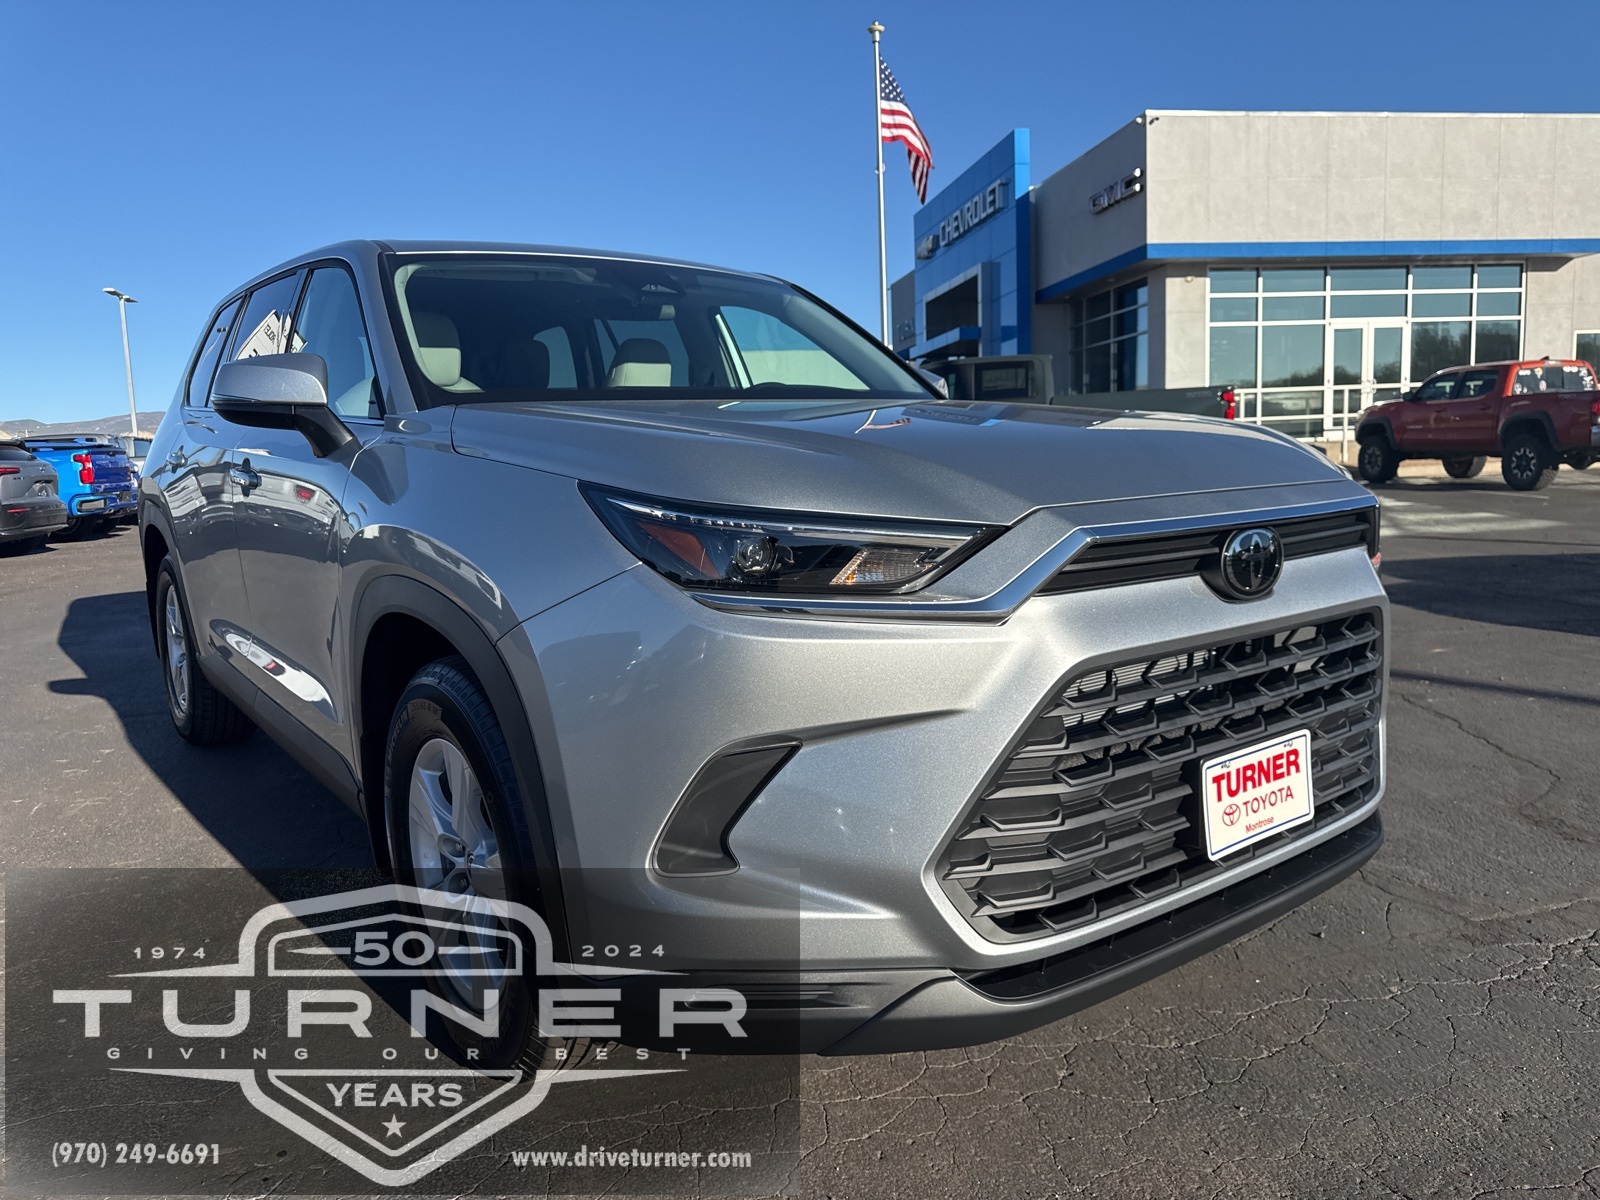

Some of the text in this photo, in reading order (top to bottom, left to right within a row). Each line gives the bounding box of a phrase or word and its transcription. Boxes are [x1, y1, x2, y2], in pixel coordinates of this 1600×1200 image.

[939, 178, 1007, 247] CHEVROLET
[1089, 167, 1142, 214] GMC
[1211, 748, 1301, 803] TURNER
[1242, 785, 1294, 817] TOYOTA
[1245, 816, 1275, 834] Montrose
